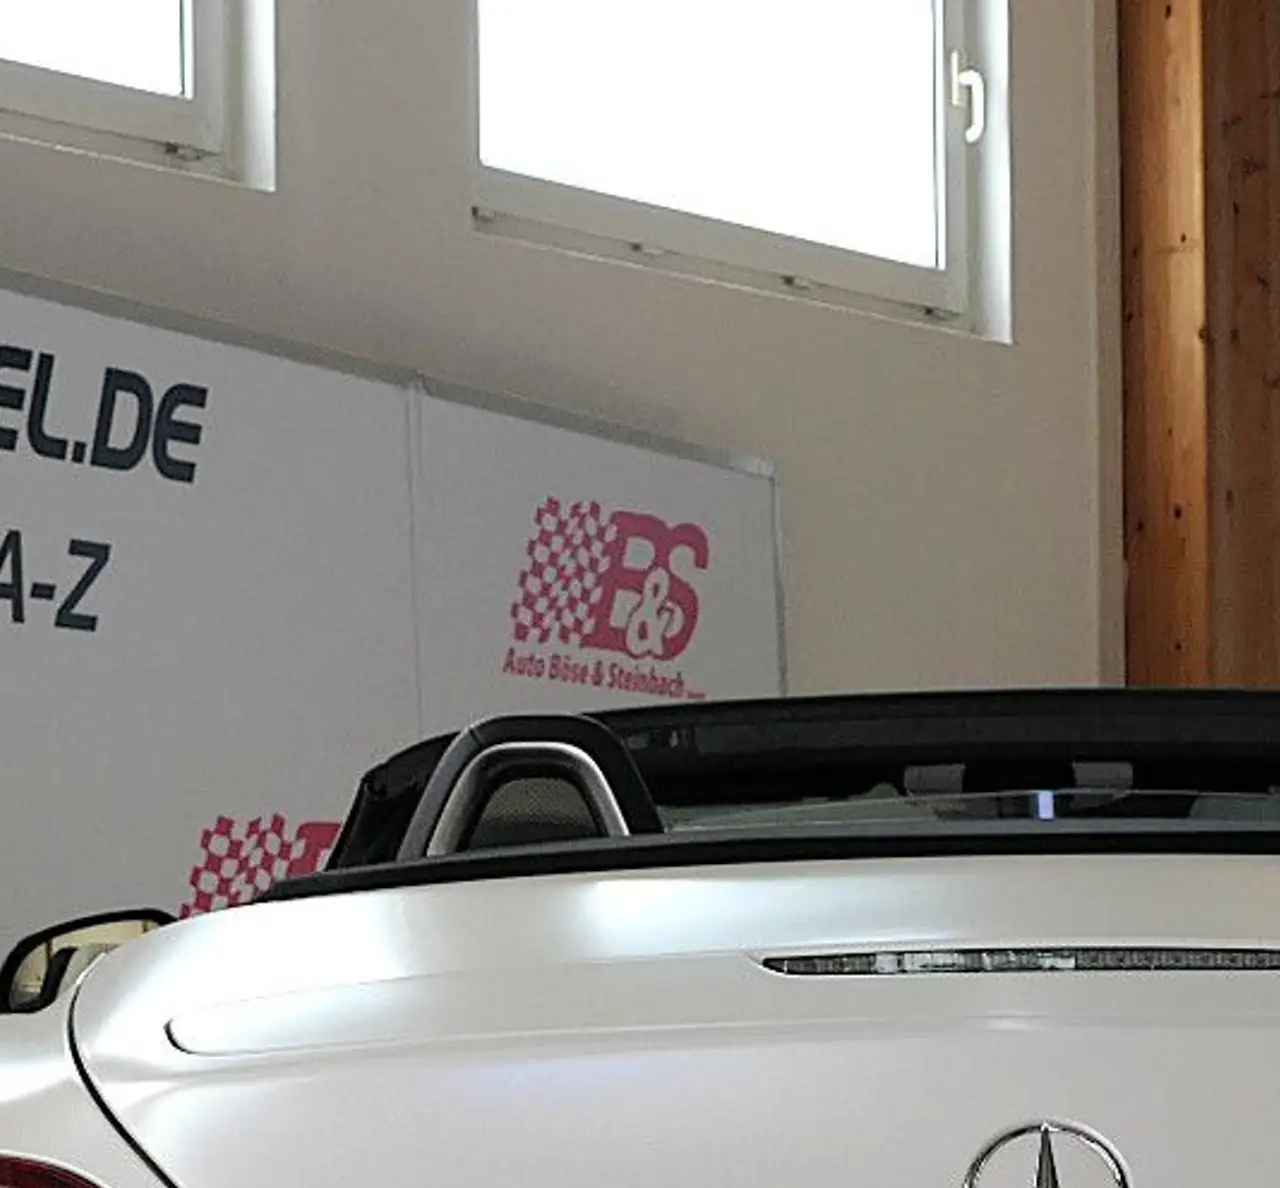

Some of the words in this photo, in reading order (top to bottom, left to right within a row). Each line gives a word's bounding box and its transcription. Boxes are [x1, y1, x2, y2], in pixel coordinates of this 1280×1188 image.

[502, 648, 546, 679] Auto
[547, 653, 591, 685] Böse
[591, 660, 604, 687] &
[607, 663, 685, 698] Steinbach
